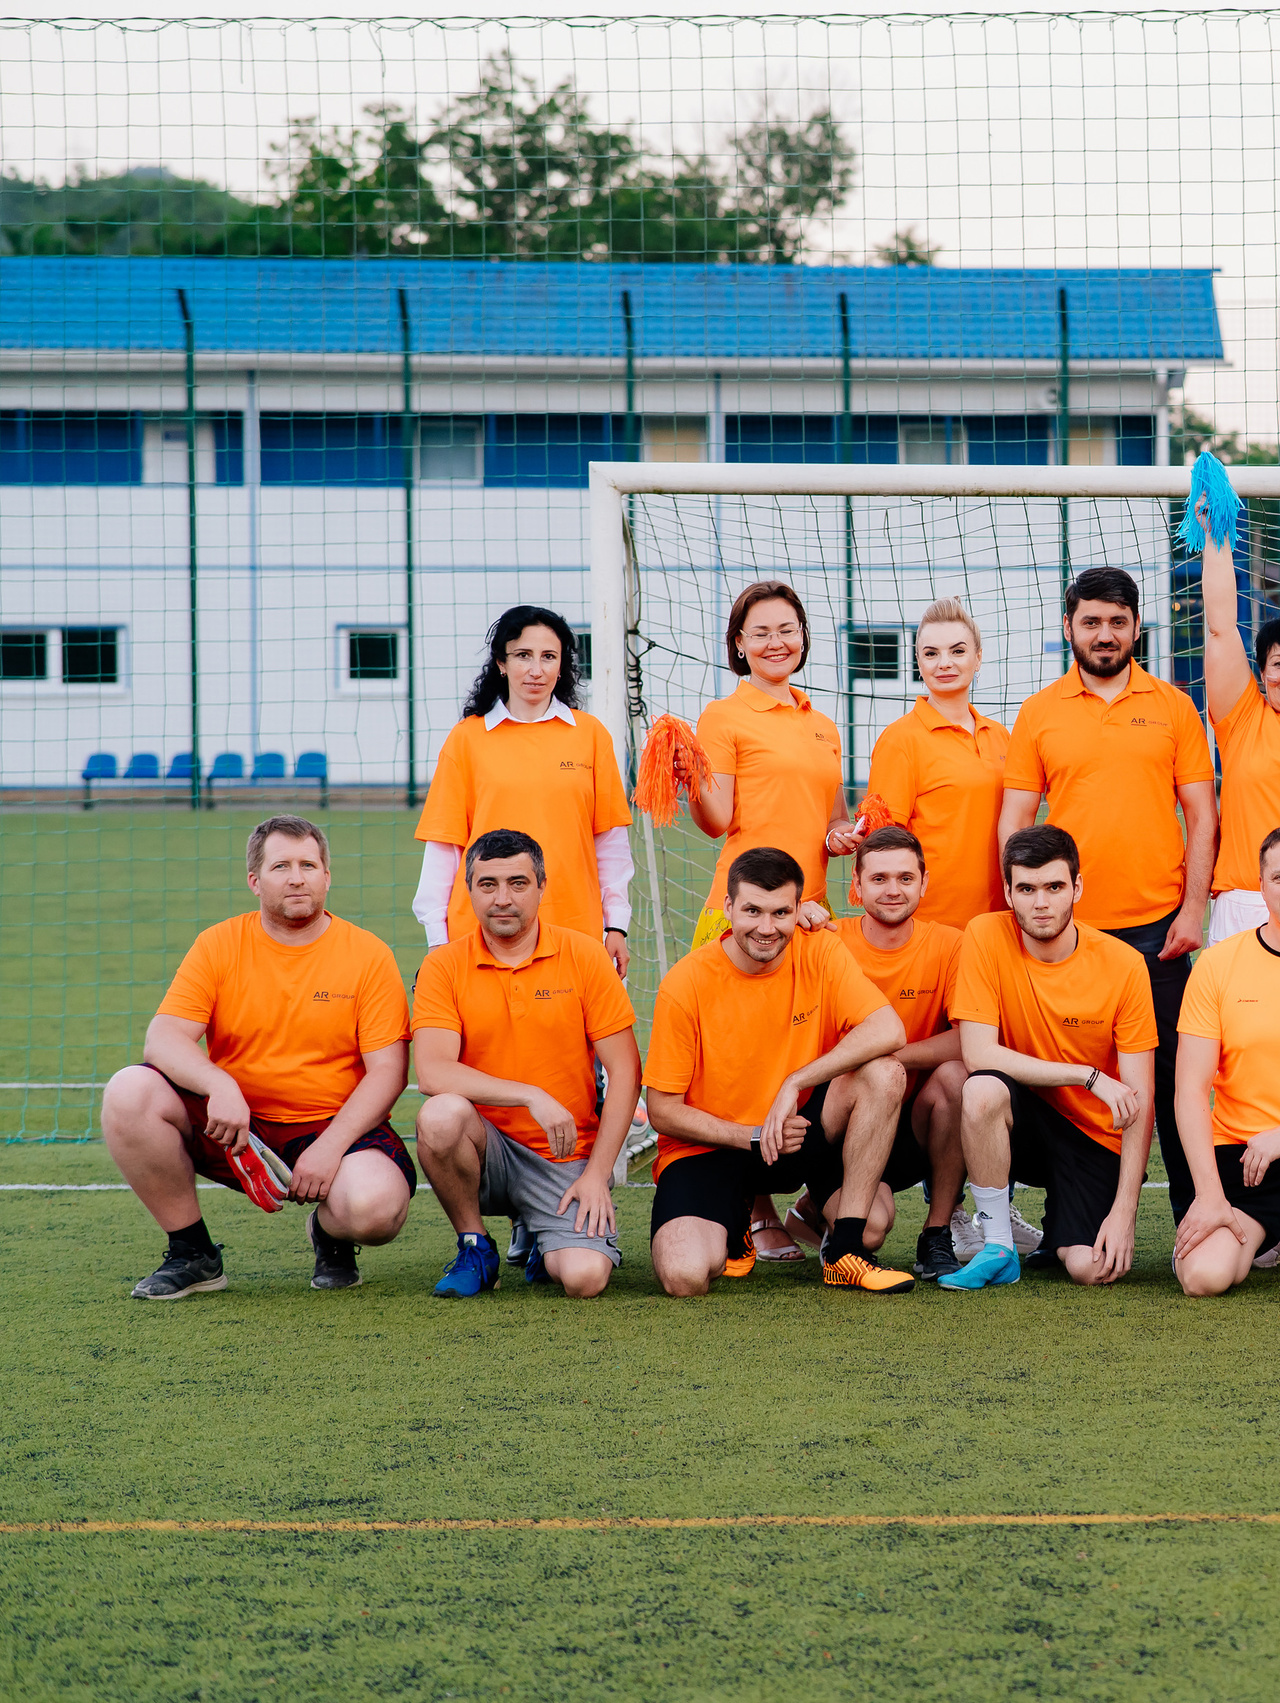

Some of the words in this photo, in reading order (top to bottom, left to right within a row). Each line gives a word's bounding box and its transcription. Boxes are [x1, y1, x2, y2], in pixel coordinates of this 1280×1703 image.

[314, 991, 329, 999] AR
[793, 1012, 806, 1022] AR
[1063, 1017, 1079, 1025] AR
